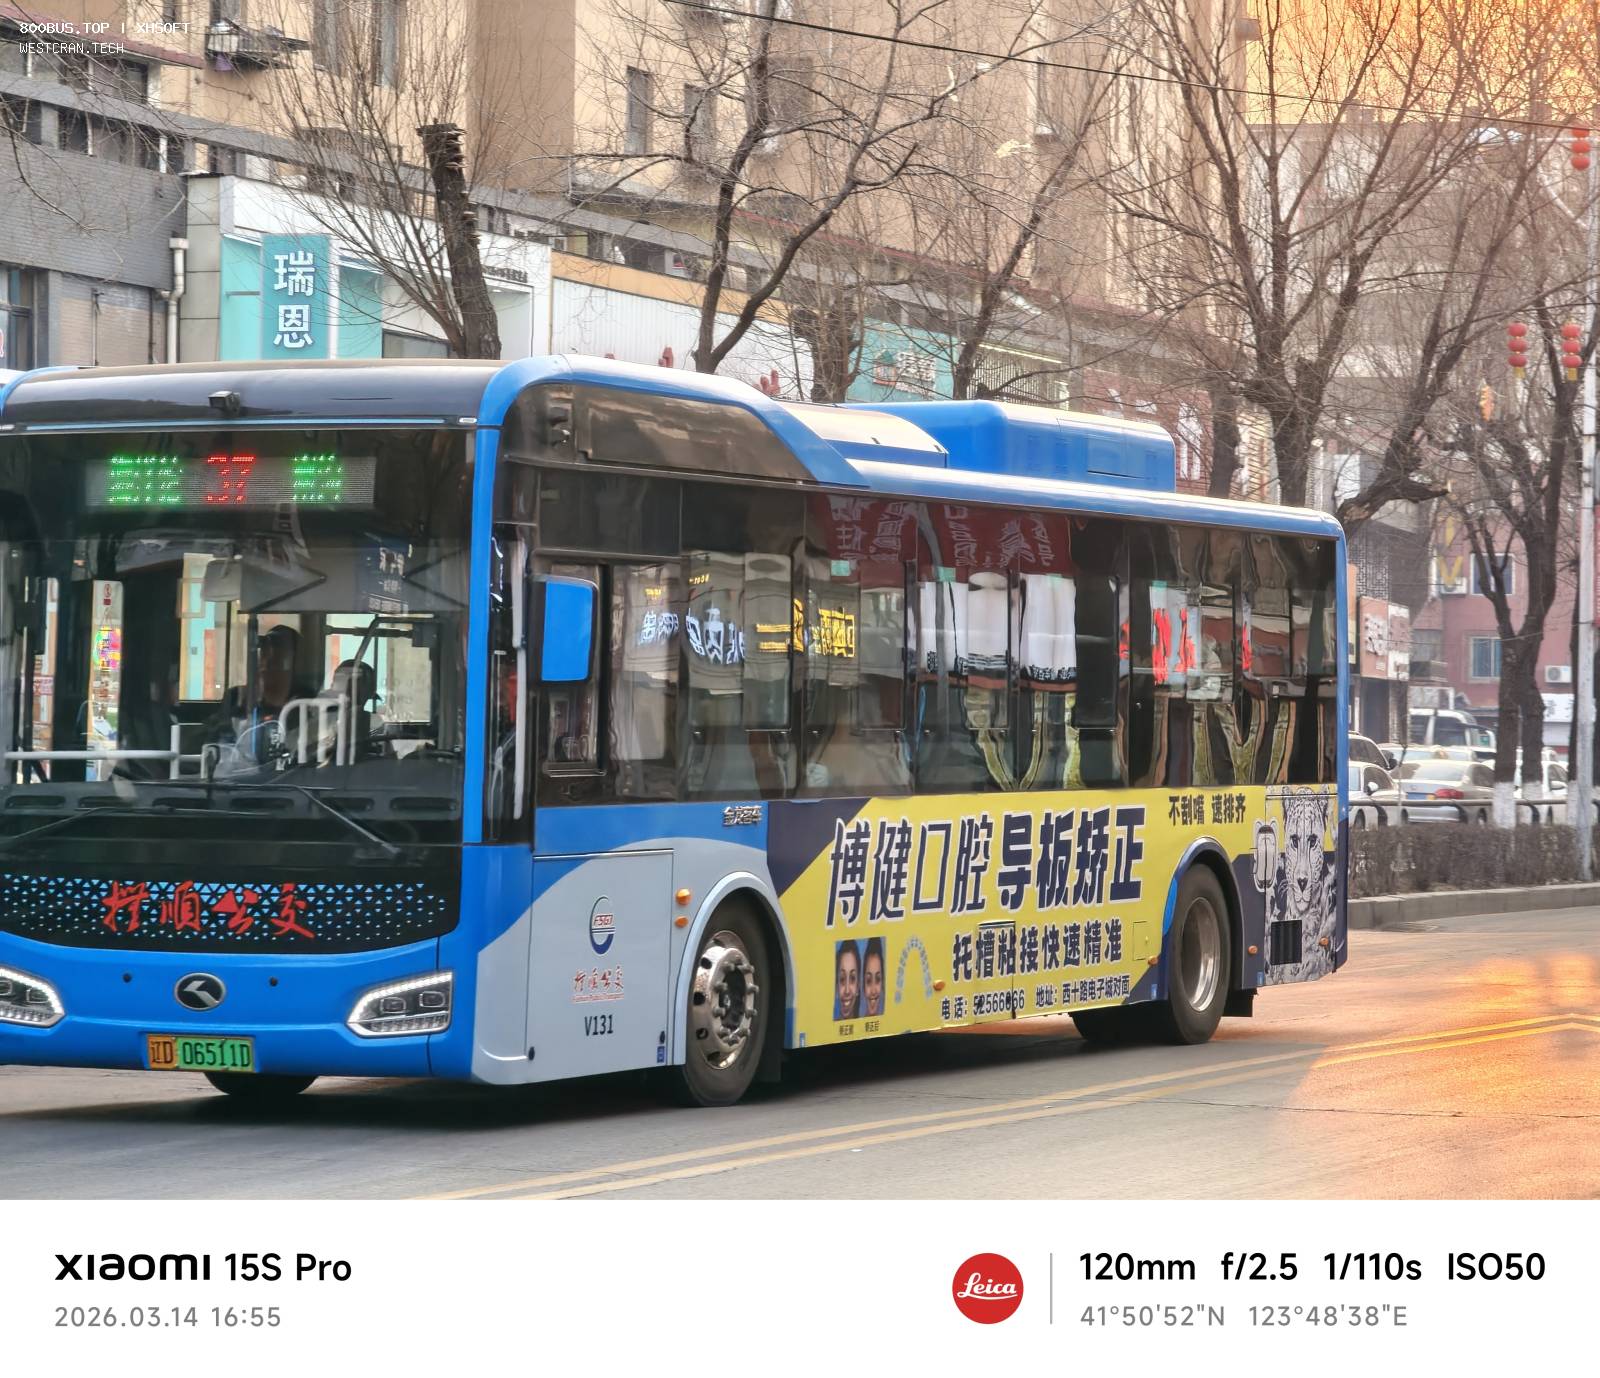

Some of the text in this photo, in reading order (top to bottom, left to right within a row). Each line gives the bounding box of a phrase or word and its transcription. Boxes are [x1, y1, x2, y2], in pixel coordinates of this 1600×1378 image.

[273, 250, 315, 349] 瑞恩
[952, 918, 1122, 982] 托槽粘接快速精准
[584, 1014, 614, 1037] V131
